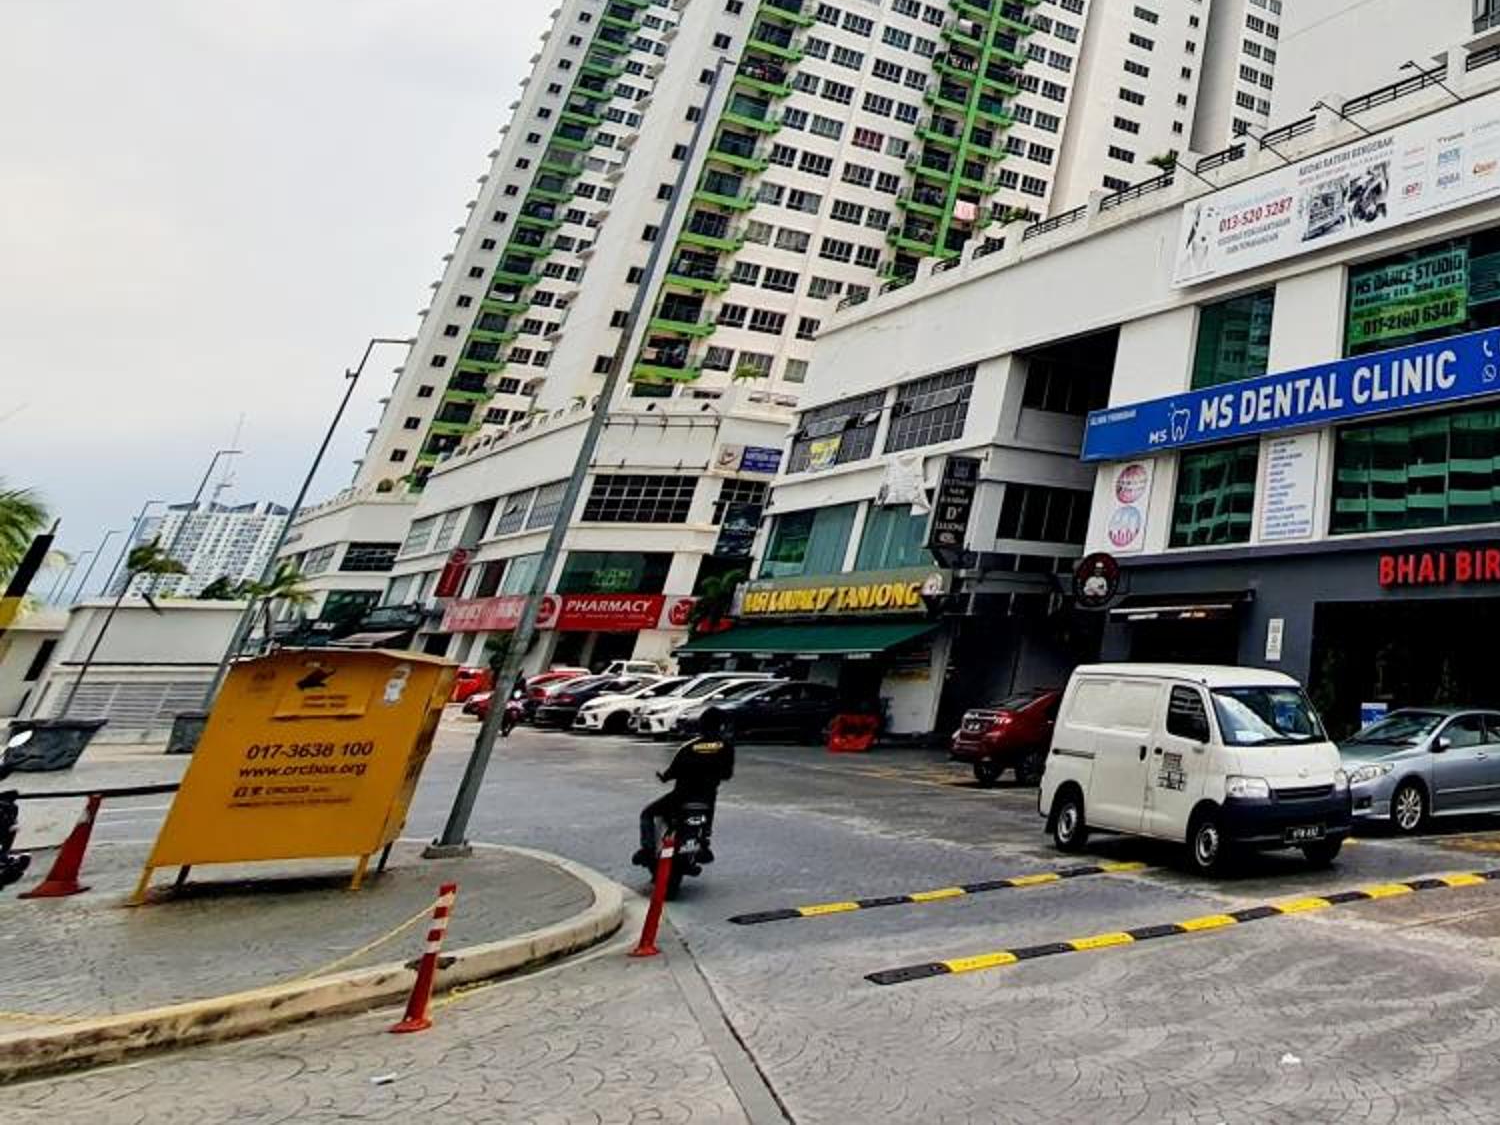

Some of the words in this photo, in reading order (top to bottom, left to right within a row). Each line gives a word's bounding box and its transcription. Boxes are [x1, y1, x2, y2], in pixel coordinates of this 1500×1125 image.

[1415, 253, 1463, 281] STUDIO
[1197, 393, 1235, 432] MS
[1239, 373, 1343, 425] DENTAL
[1352, 350, 1457, 405] CLINIC
[1149, 429, 1168, 443] MS
[1379, 552, 1446, 585] BHAI
[565, 600, 653, 612] PHARMACY
[837, 581, 922, 611] TANJONG
[246, 743, 334, 760] 017-3638
[341, 741, 375, 756] 100
